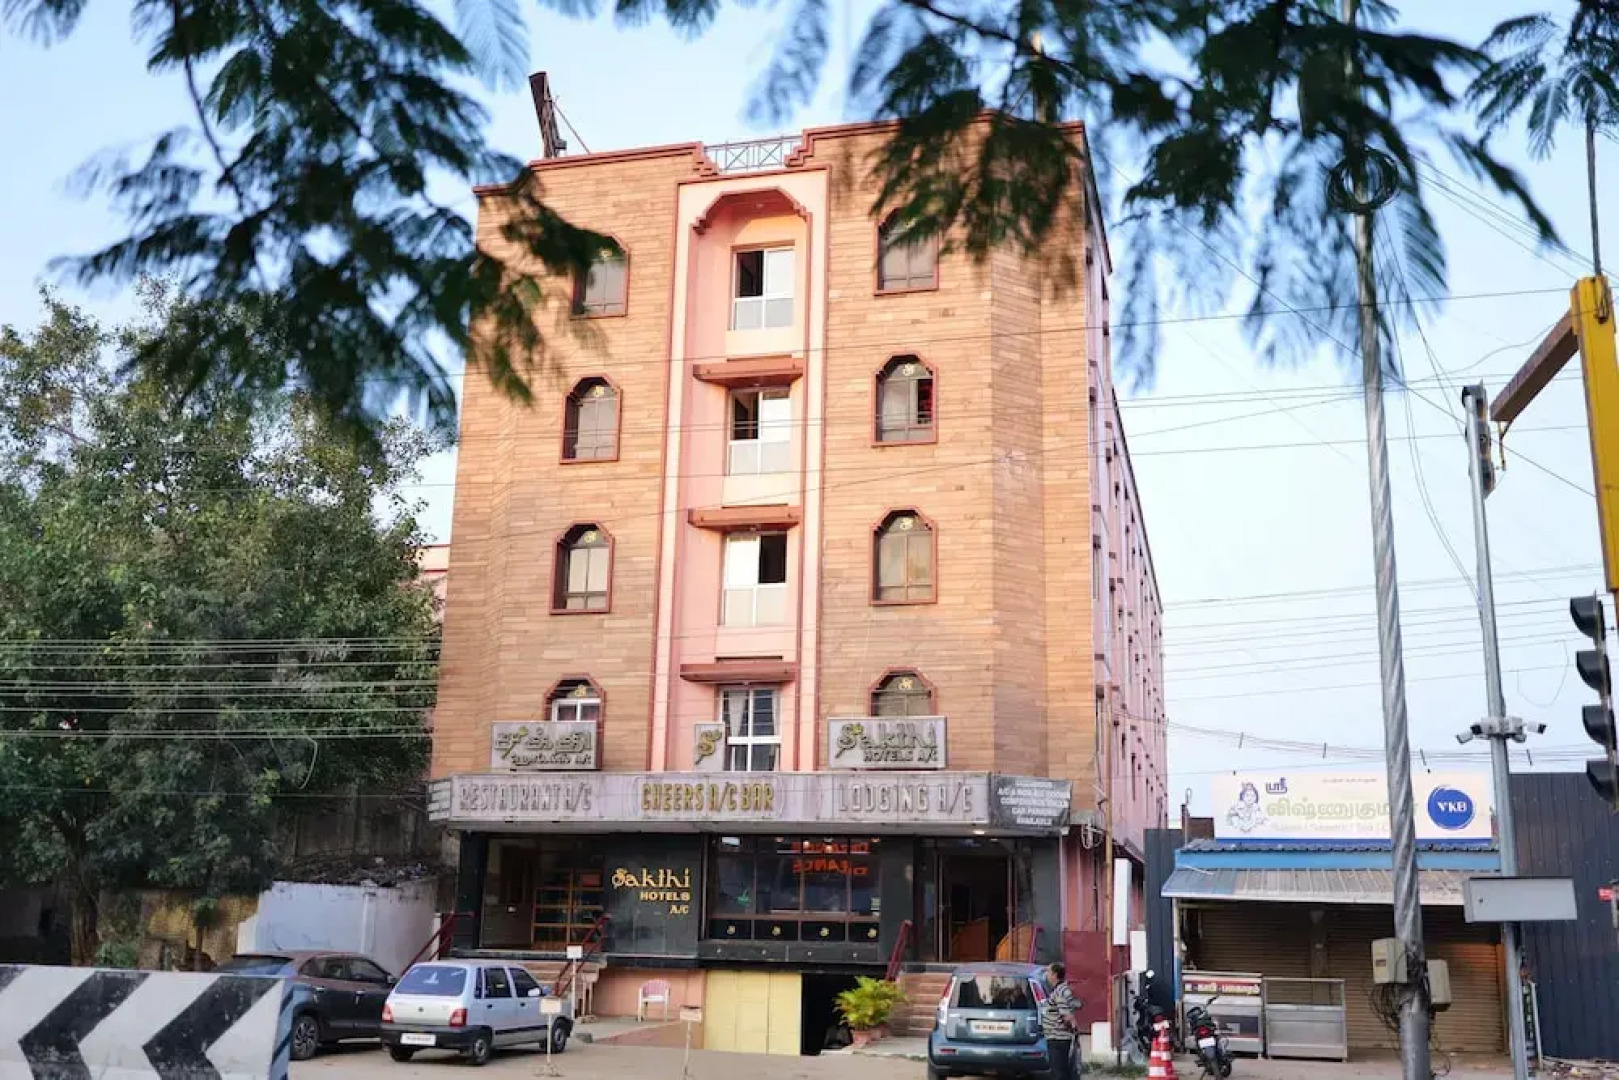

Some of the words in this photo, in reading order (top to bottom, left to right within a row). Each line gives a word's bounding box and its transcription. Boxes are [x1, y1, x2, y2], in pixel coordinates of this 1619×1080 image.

[863, 750, 914, 762] HOTELS
[917, 749, 938, 763] A/C
[459, 783, 562, 811] RESTAURANT
[564, 782, 593, 813] A/C
[641, 783, 705, 811] CHEERS
[708, 782, 738, 813] A/C
[740, 783, 775, 811] BAR
[839, 784, 928, 812] LODGING
[938, 782, 973, 815] A/C
[1437, 801, 1467, 813] VKB
[611, 867, 691, 889] Sakthi
[640, 891, 691, 901] HOTELS
